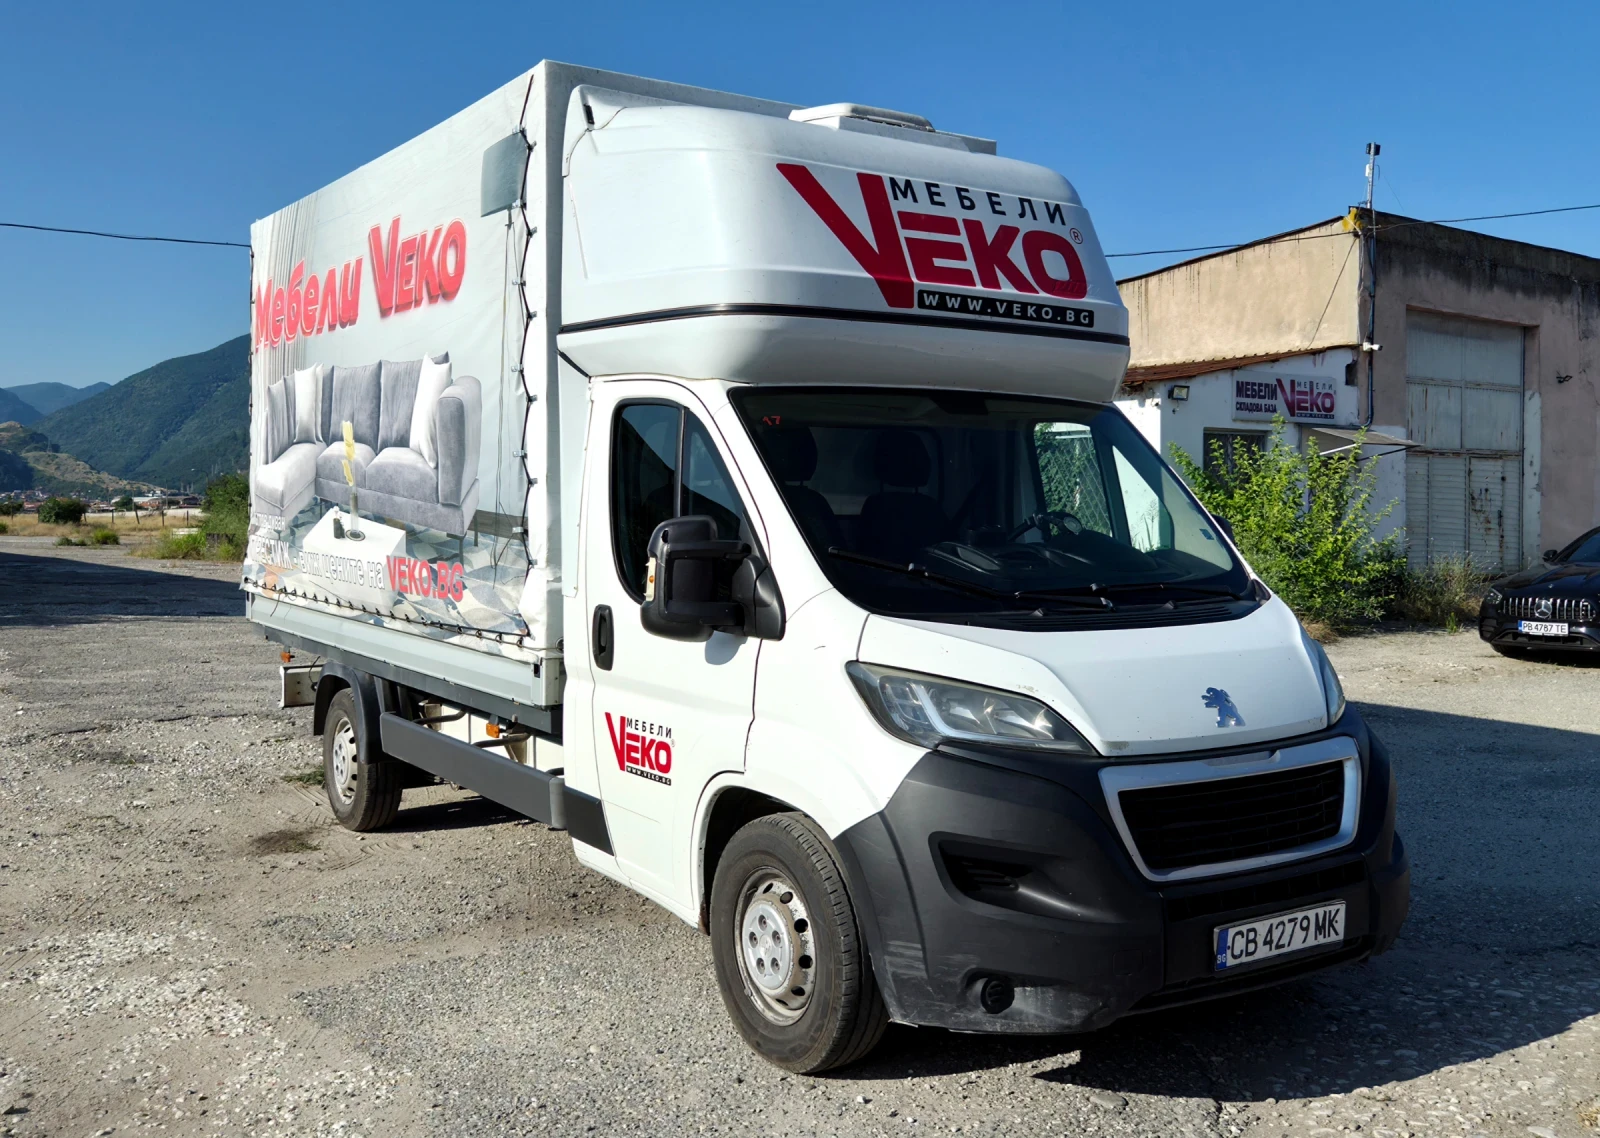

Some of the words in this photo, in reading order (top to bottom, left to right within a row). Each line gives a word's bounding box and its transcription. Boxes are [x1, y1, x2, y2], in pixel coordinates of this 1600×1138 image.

[888, 176, 1067, 226] МЕБЕЛИ
[776, 163, 1088, 309] VEKO
[255, 255, 364, 354] Мебели
[922, 291, 1091, 326] WWW.VEKO.BG
[1235, 380, 1278, 401] МЕБЕЛИ
[1235, 401, 1263, 413] СКЛАДОВА
[1263, 403, 1277, 413] БАЗА
[367, 561, 385, 590] на
[386, 554, 464, 602] VEKO.BG
[1555, 624, 1567, 634] TE
[604, 711, 672, 774] VEKO
[626, 717, 672, 739] МЕБЕЛИ
[1230, 927, 1258, 960] CB
[1262, 915, 1311, 952] 4279
[1314, 907, 1341, 941] MK
